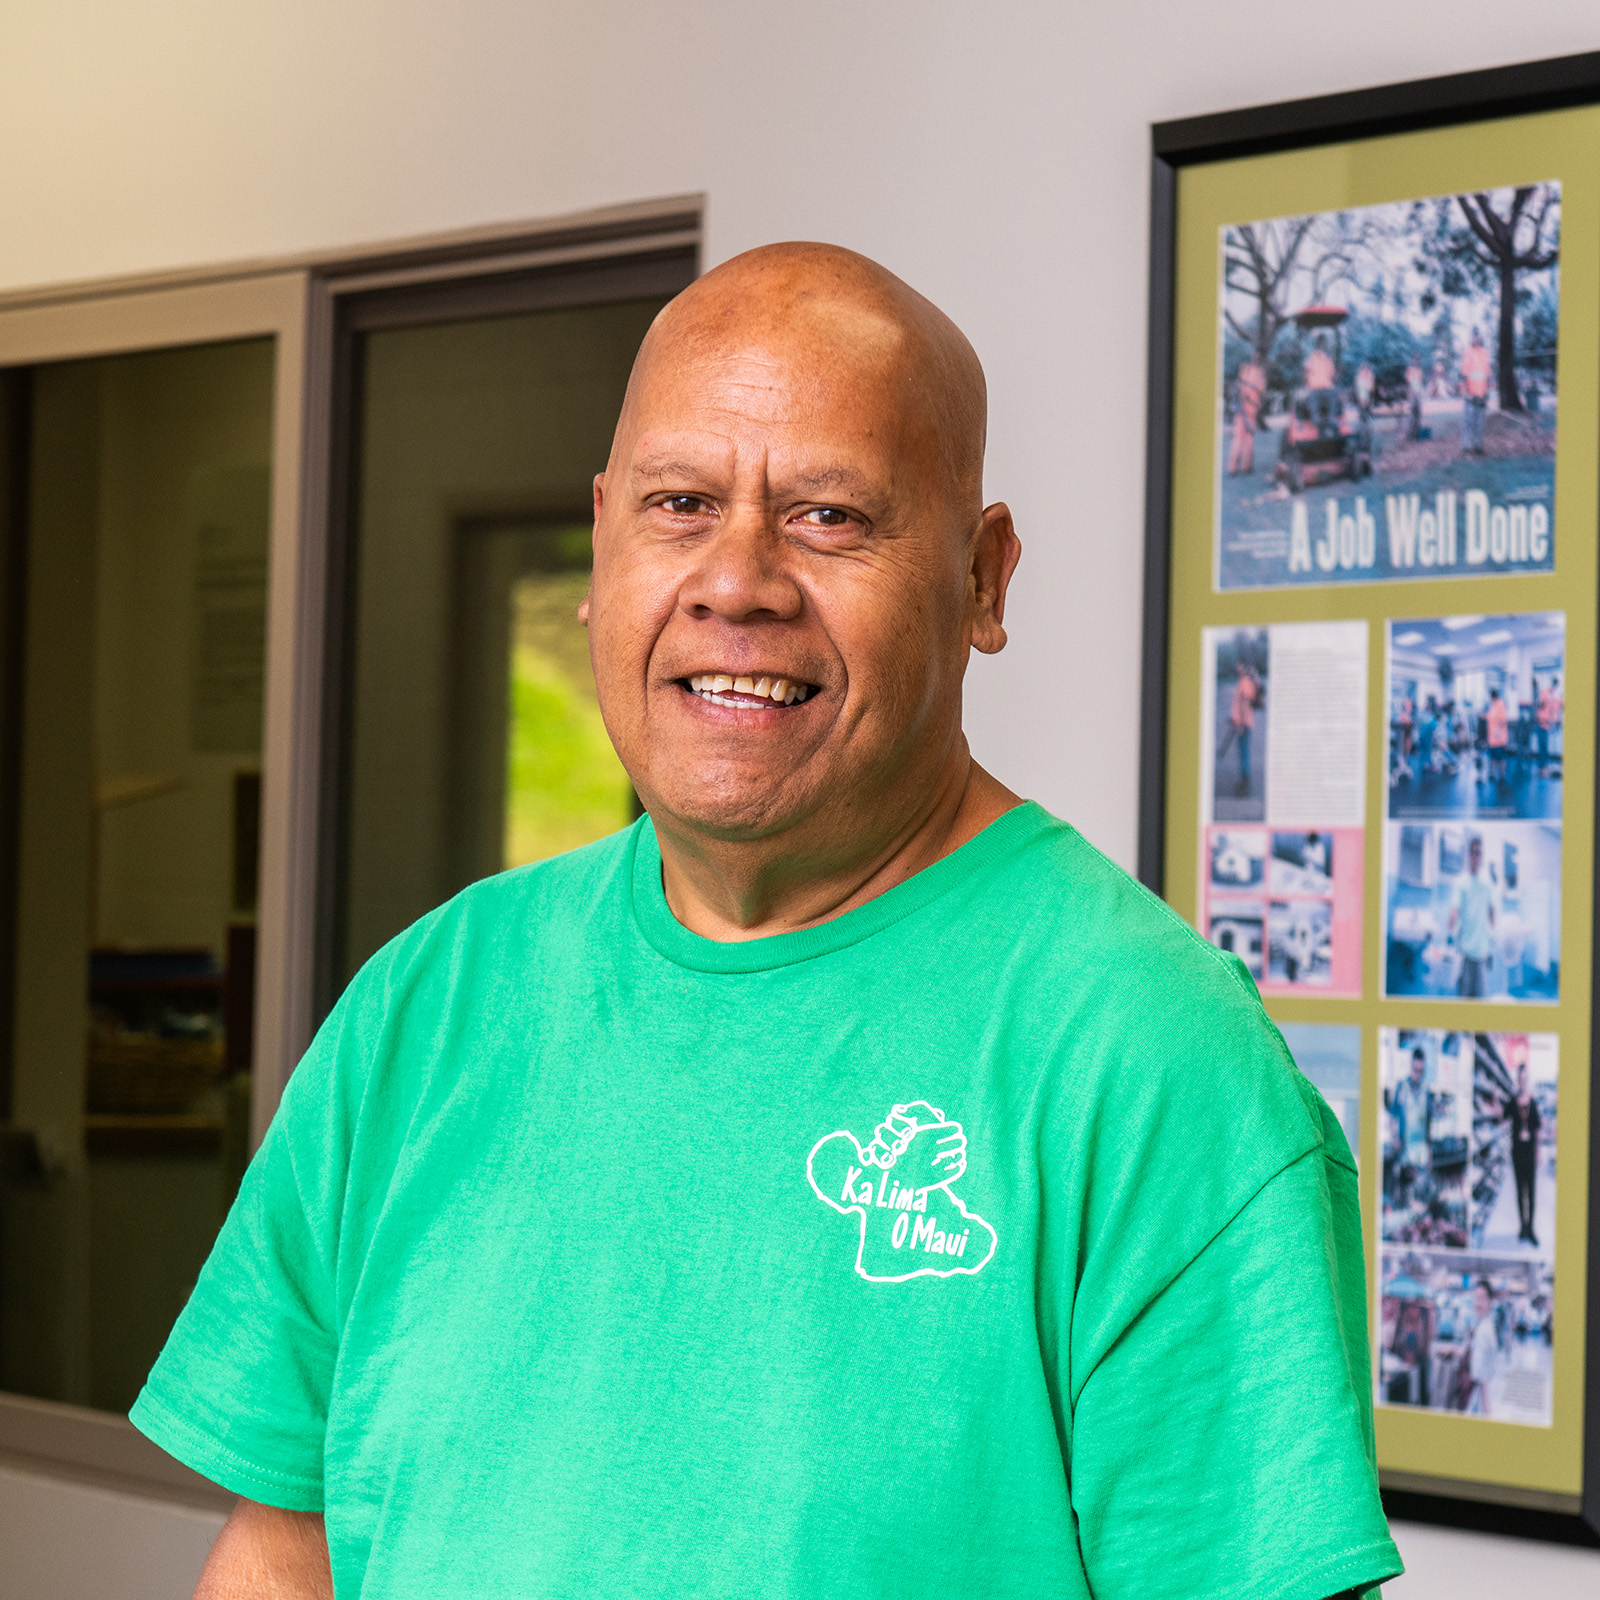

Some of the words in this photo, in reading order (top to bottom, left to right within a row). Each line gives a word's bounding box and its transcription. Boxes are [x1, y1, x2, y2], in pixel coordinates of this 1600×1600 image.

[1289, 500, 1312, 573] A
[1316, 496, 1376, 572] Job
[1385, 489, 1457, 568] Well
[1465, 488, 1549, 565] Done
[841, 1165, 873, 1205] Ka
[876, 1171, 928, 1212] Lima
[891, 1212, 909, 1249] O
[909, 1214, 970, 1257] Maui
